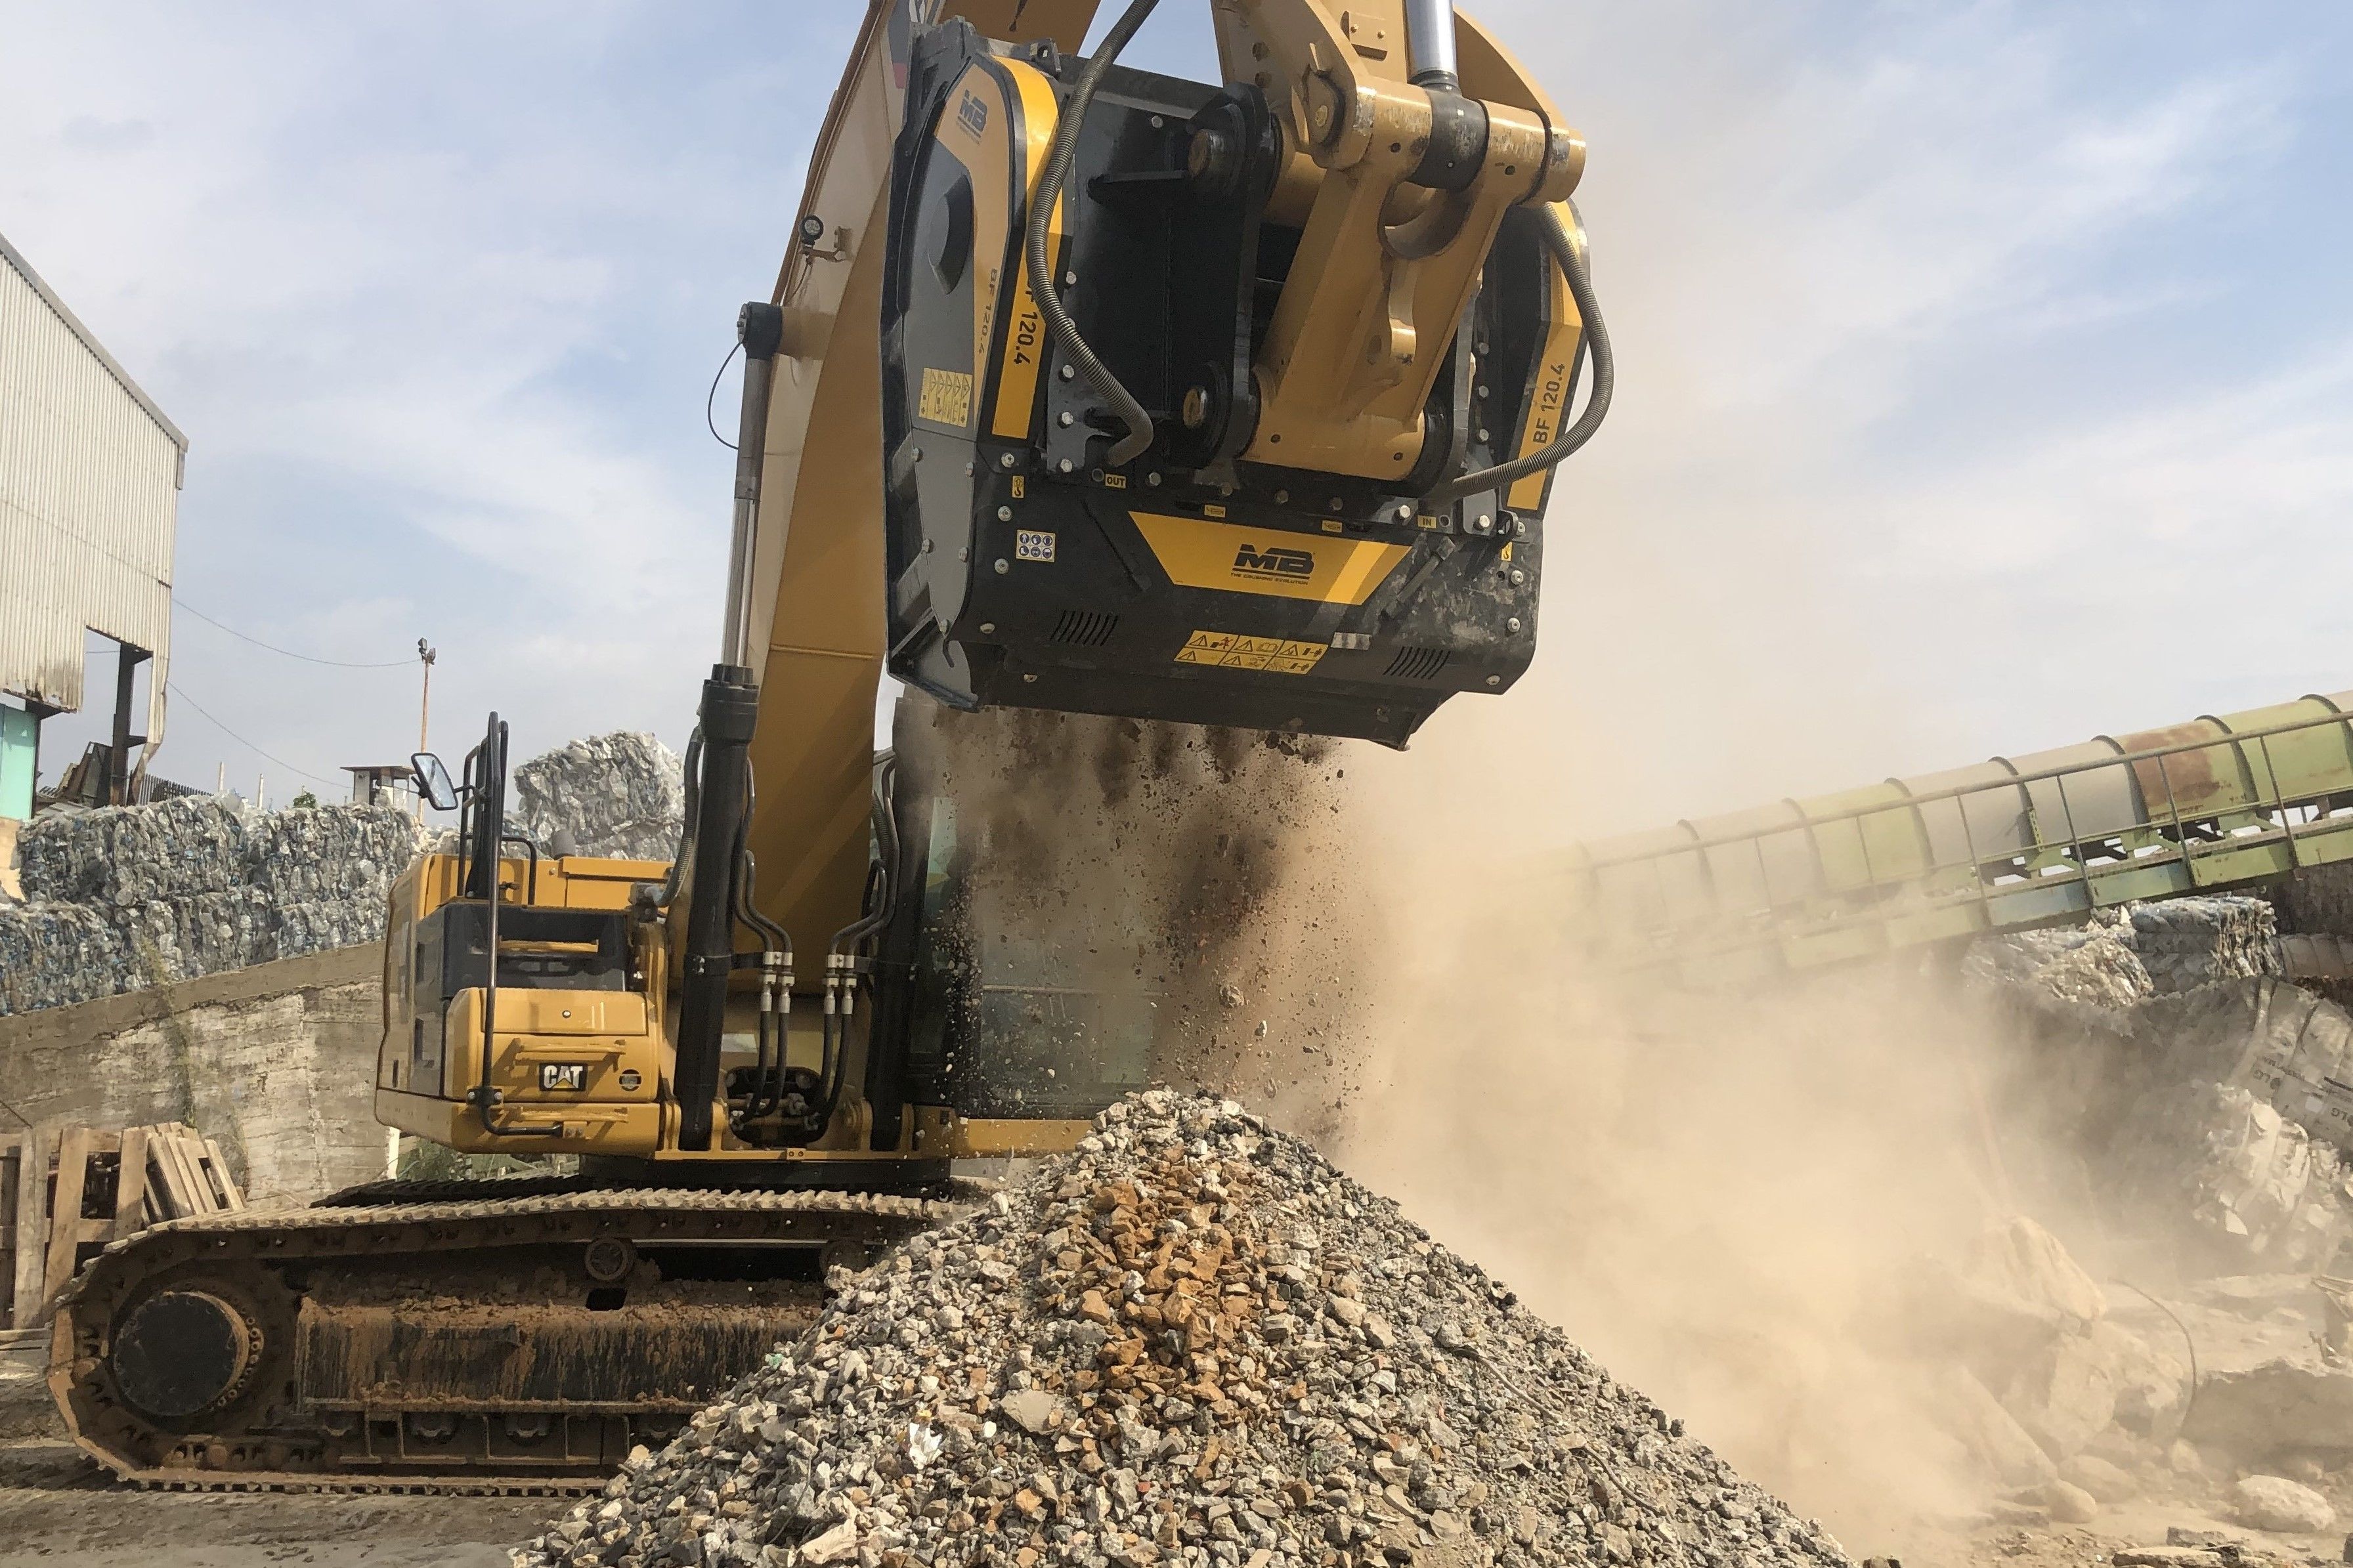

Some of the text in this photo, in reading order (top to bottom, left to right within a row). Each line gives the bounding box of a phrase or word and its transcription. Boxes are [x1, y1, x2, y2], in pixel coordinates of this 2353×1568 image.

[959, 89, 987, 133] MB
[978, 268, 998, 356] BF 120.4
[1014, 311, 1038, 364] 120.4
[1532, 364, 1565, 444] BF 120.4
[1106, 477, 1125, 486] OUT
[1423, 517, 1432, 526] IN
[1234, 543, 1314, 574] MB
[544, 1065, 584, 1089] CAT
[2331, 1107, 2348, 1121] LG
